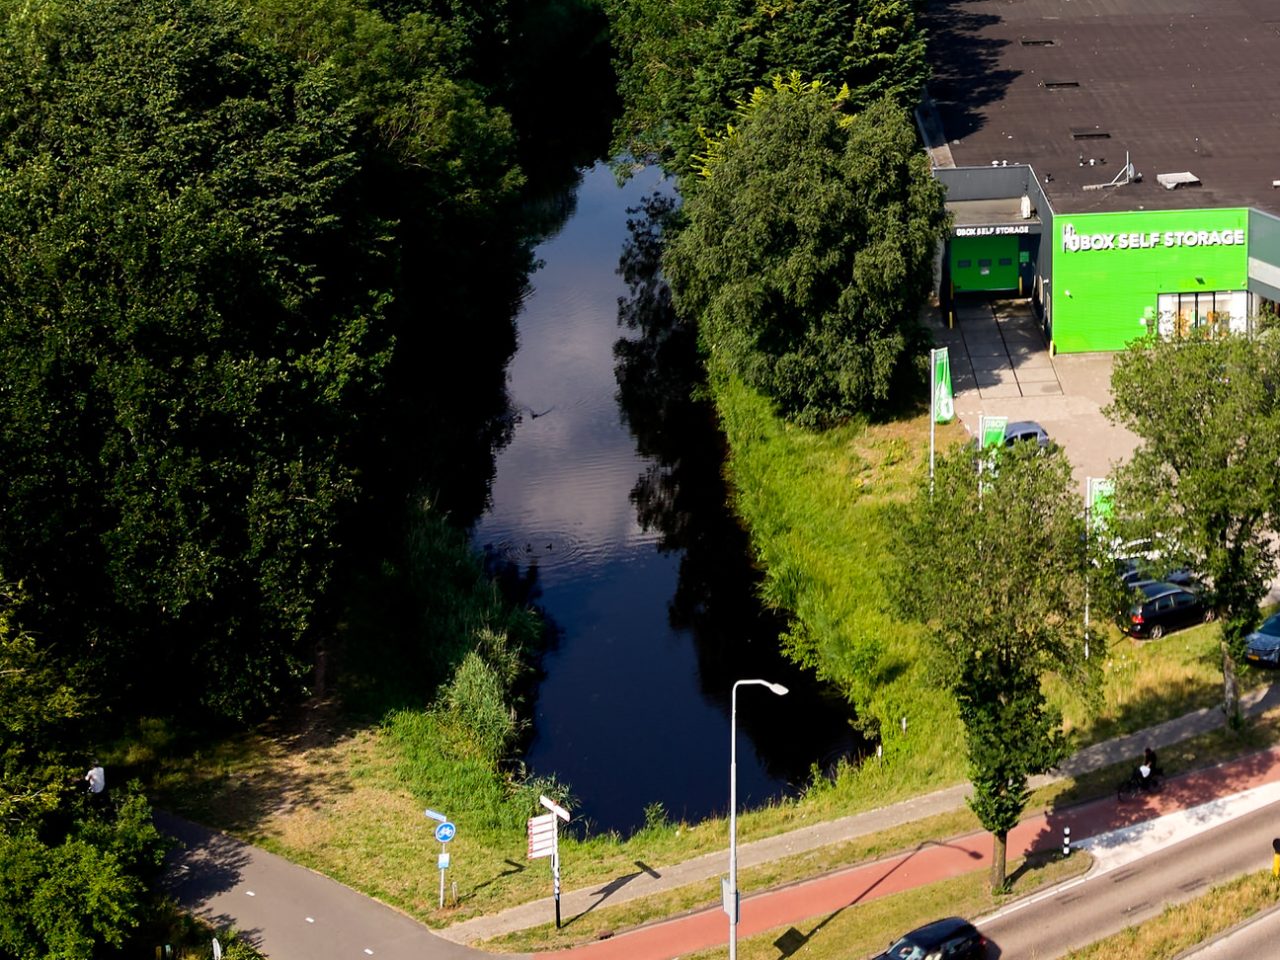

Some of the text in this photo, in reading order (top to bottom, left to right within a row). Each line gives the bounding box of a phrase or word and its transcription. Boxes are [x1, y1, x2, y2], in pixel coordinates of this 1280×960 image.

[976, 227, 995, 236] SELF
[995, 226, 1029, 235] STORAGE
[1118, 233, 1160, 249] SELF
[1163, 230, 1245, 248] STORAGE
